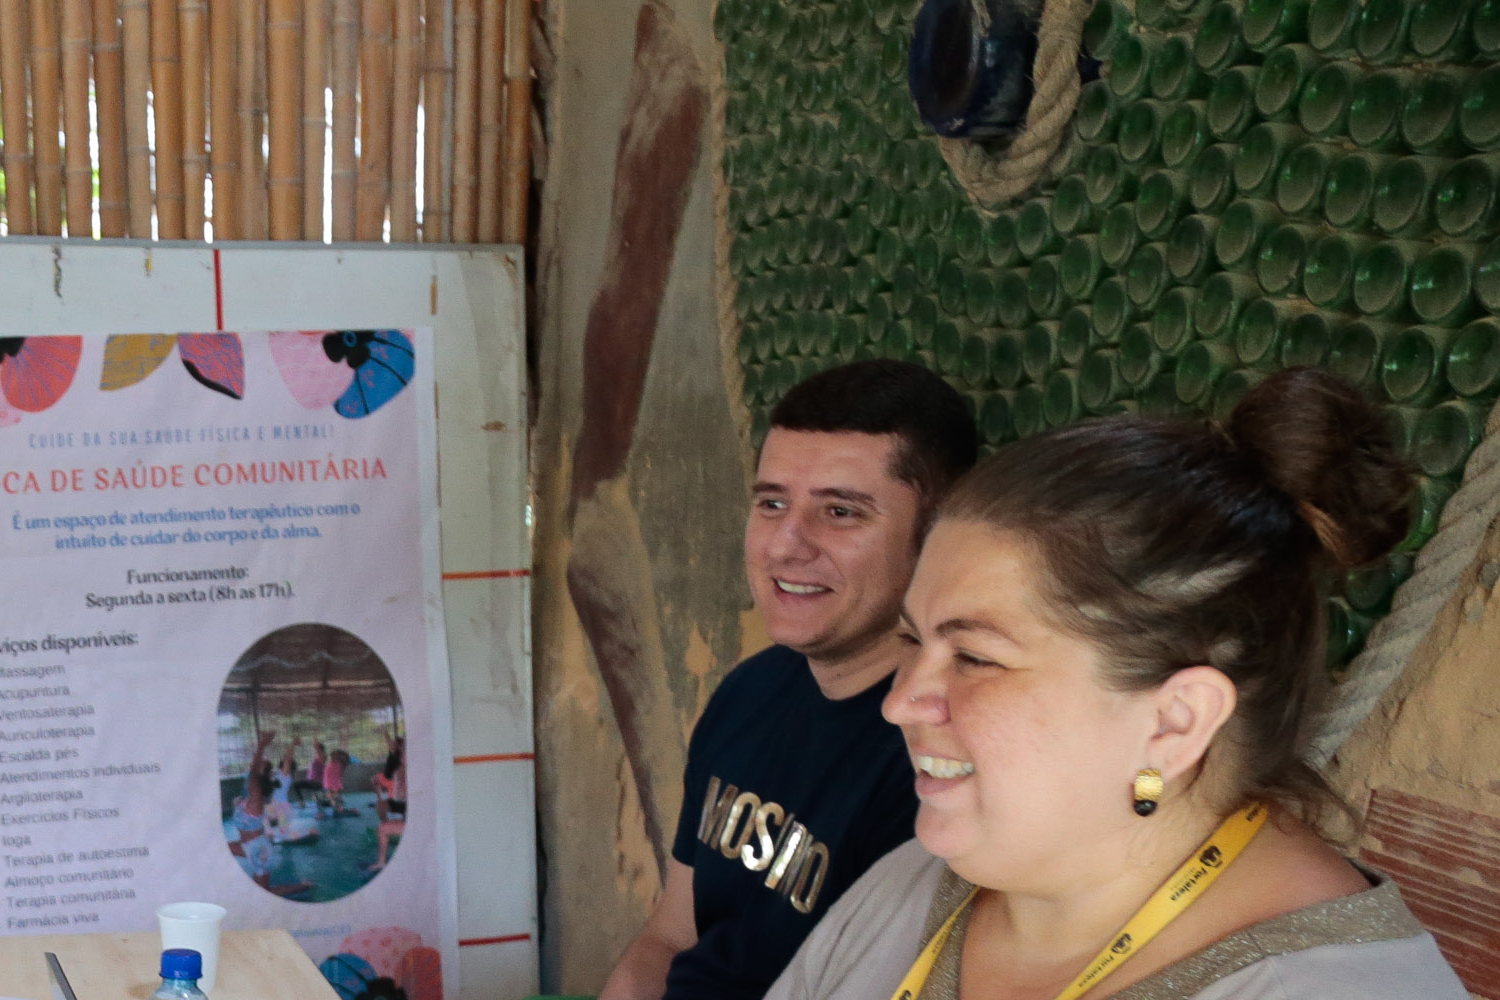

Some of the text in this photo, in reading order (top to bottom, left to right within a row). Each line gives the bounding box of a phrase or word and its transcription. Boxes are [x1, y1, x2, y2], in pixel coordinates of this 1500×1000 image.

[29, 422, 334, 448] CUIDE DA SUA SAÚDE FÍSICA E MENTAL!
[51, 467, 84, 492] DE
[94, 459, 185, 490] SAÚDE
[194, 452, 388, 487] COMUNITÁRIA
[12, 502, 360, 533] É um espaço de atendimento terapêutico com o
[54, 523, 322, 551] intuito de cuidar do corpo e da alma.
[126, 565, 249, 586] Funcionamento:
[85, 581, 296, 612] Segunda a sexta (8h as 17h).
[40, 630, 139, 654] disponíveis:
[54, 746, 79, 763] pés
[0, 760, 161, 785] Atendimentos individuais
[0, 788, 84, 808] Argiloterapia
[1, 804, 120, 827] Exercícios Físicos
[3, 833, 32, 850] Ioga
[4, 845, 149, 871] Terapia de autoestima
[4, 866, 134, 893] Almoço comunitário
[6, 886, 136, 912] Terapia comunitária
[7, 910, 100, 930] Farmácia viva
